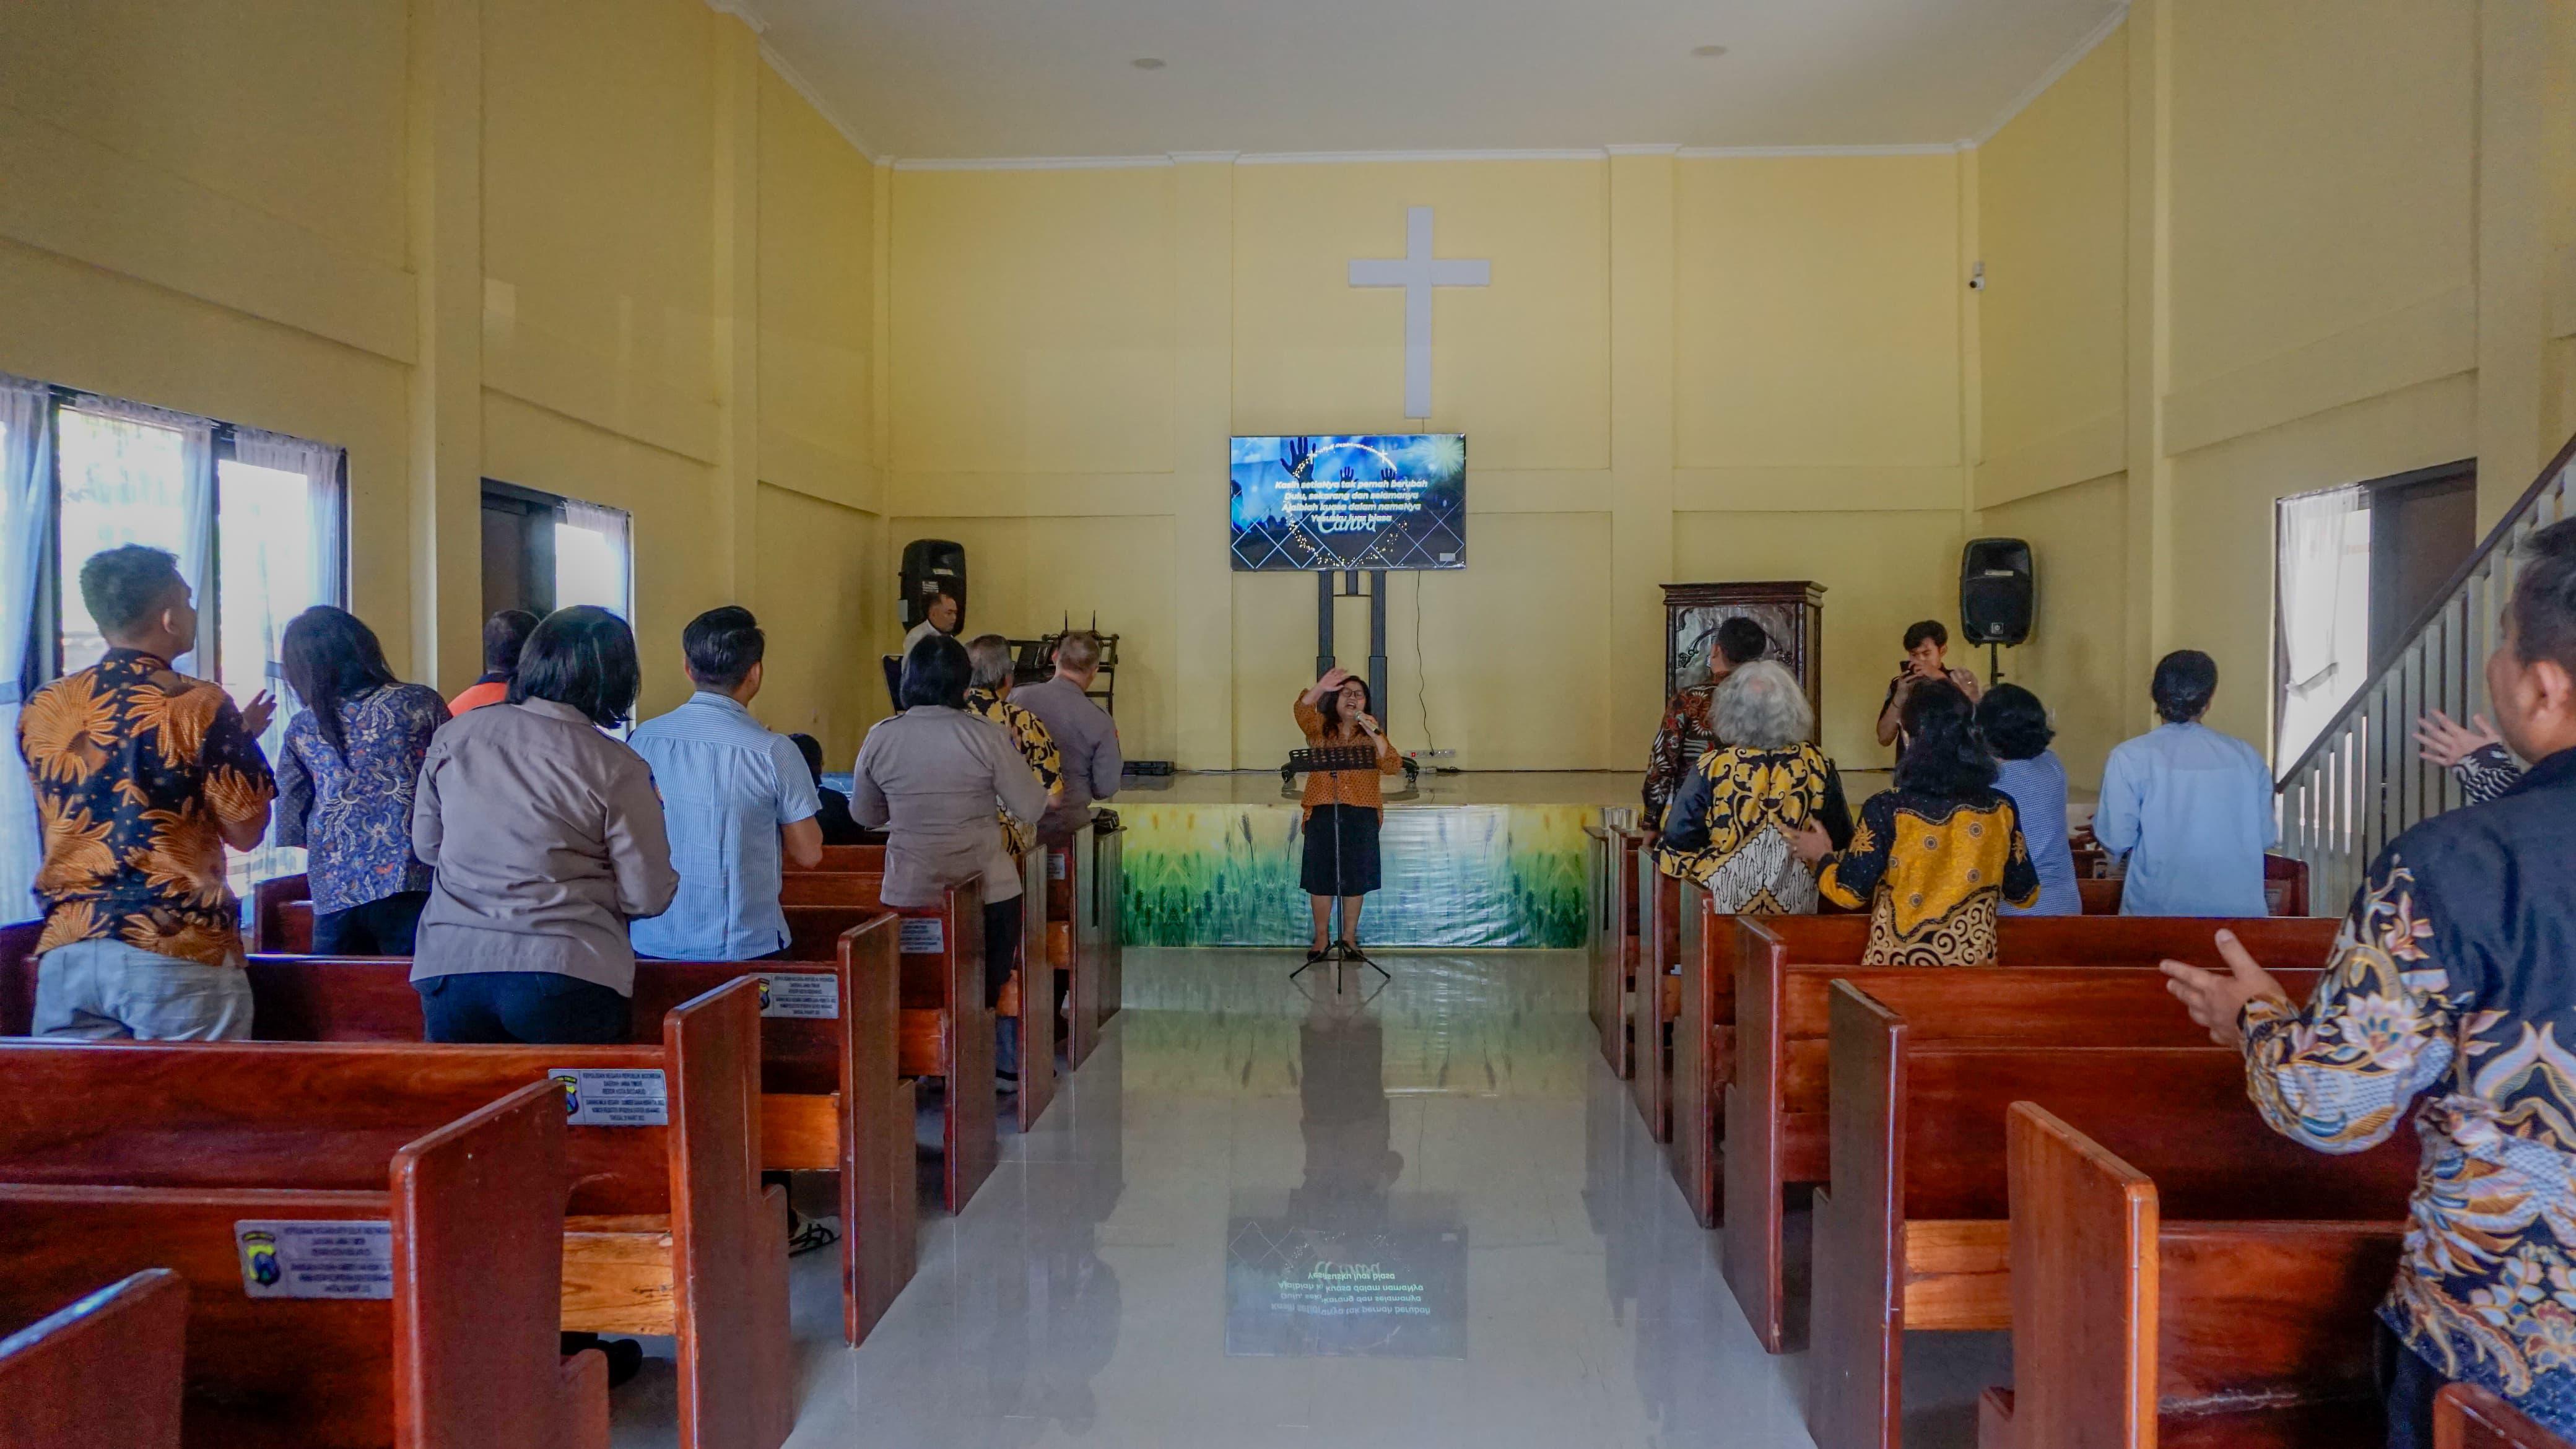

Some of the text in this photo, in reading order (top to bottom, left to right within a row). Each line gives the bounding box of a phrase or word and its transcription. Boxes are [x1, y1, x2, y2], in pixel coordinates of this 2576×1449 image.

[1301, 481, 1339, 490] setiaNya
[1341, 480, 1356, 488] tak
[1357, 480, 1388, 490] pernah
[1391, 480, 1428, 489] berubah
[1284, 492, 1419, 501] Dulu, sekarang dan selamanya
[1349, 502, 1377, 511] dalam
[1378, 503, 1421, 512] namaNya
